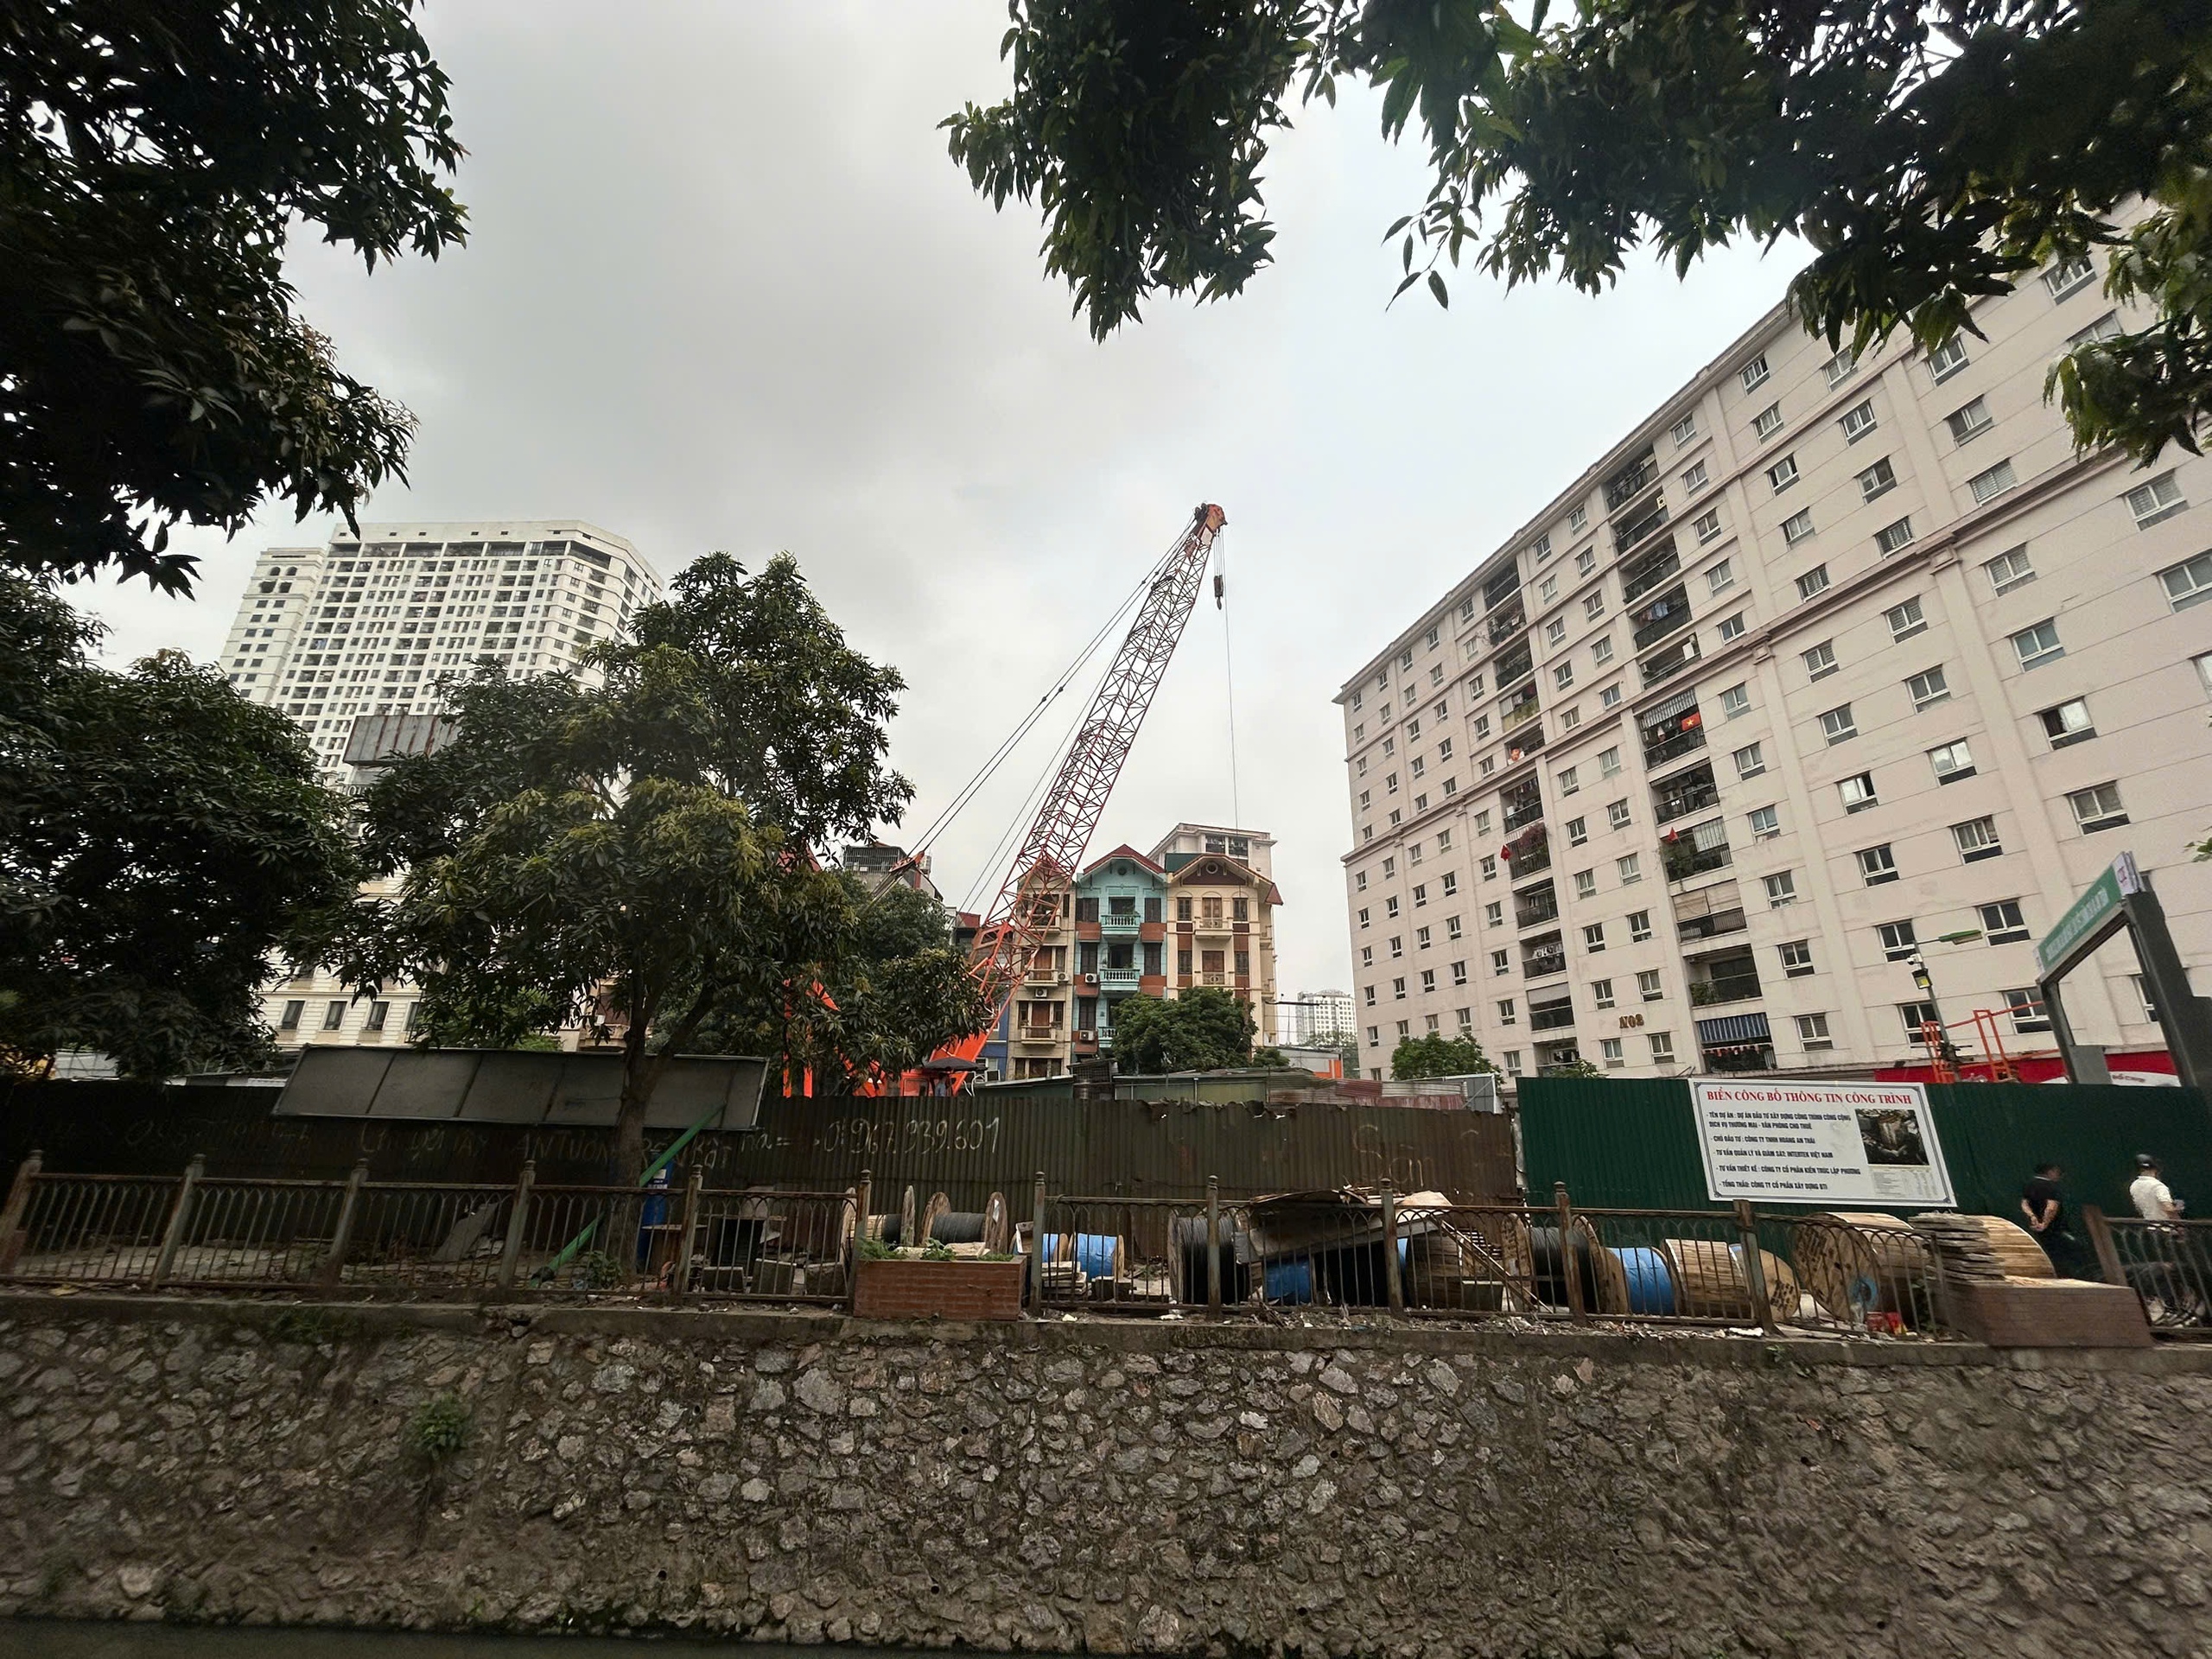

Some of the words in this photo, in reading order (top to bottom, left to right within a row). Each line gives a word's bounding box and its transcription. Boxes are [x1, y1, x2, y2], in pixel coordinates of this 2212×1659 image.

[1707, 1086, 1732, 1101] BIỂN
[1735, 1089, 1764, 1102] CÔNG
[1766, 1087, 1782, 1102] BỐ
[1784, 1090, 1822, 1103] THÔNG
[1823, 1092, 1843, 1103] TIN
[1845, 1091, 1876, 1103] CÔNG
[1877, 1092, 1912, 1104] TRÌNH
